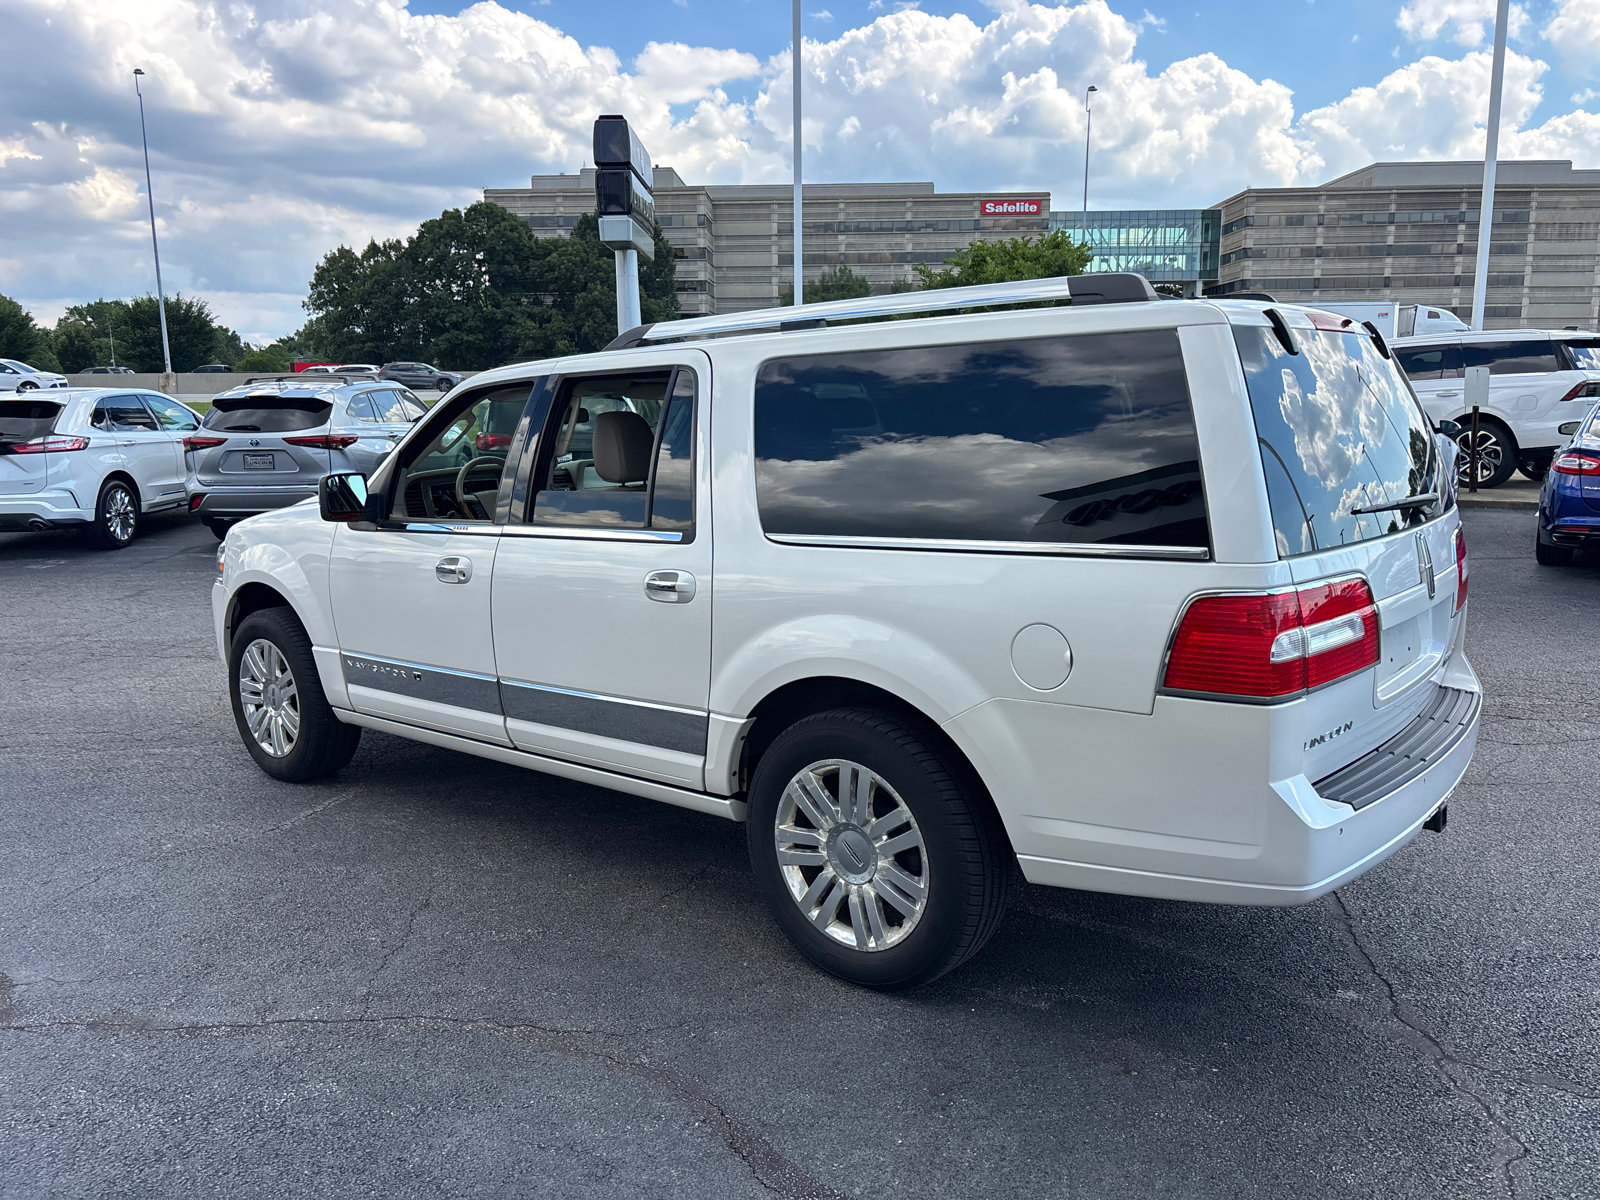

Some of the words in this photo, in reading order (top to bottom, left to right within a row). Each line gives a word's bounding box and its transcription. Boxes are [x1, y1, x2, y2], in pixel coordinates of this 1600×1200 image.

[985, 202, 1038, 213] Safelite
[346, 659, 407, 679] NAVIGATOR
[1303, 720, 1353, 752] LINCOLN
